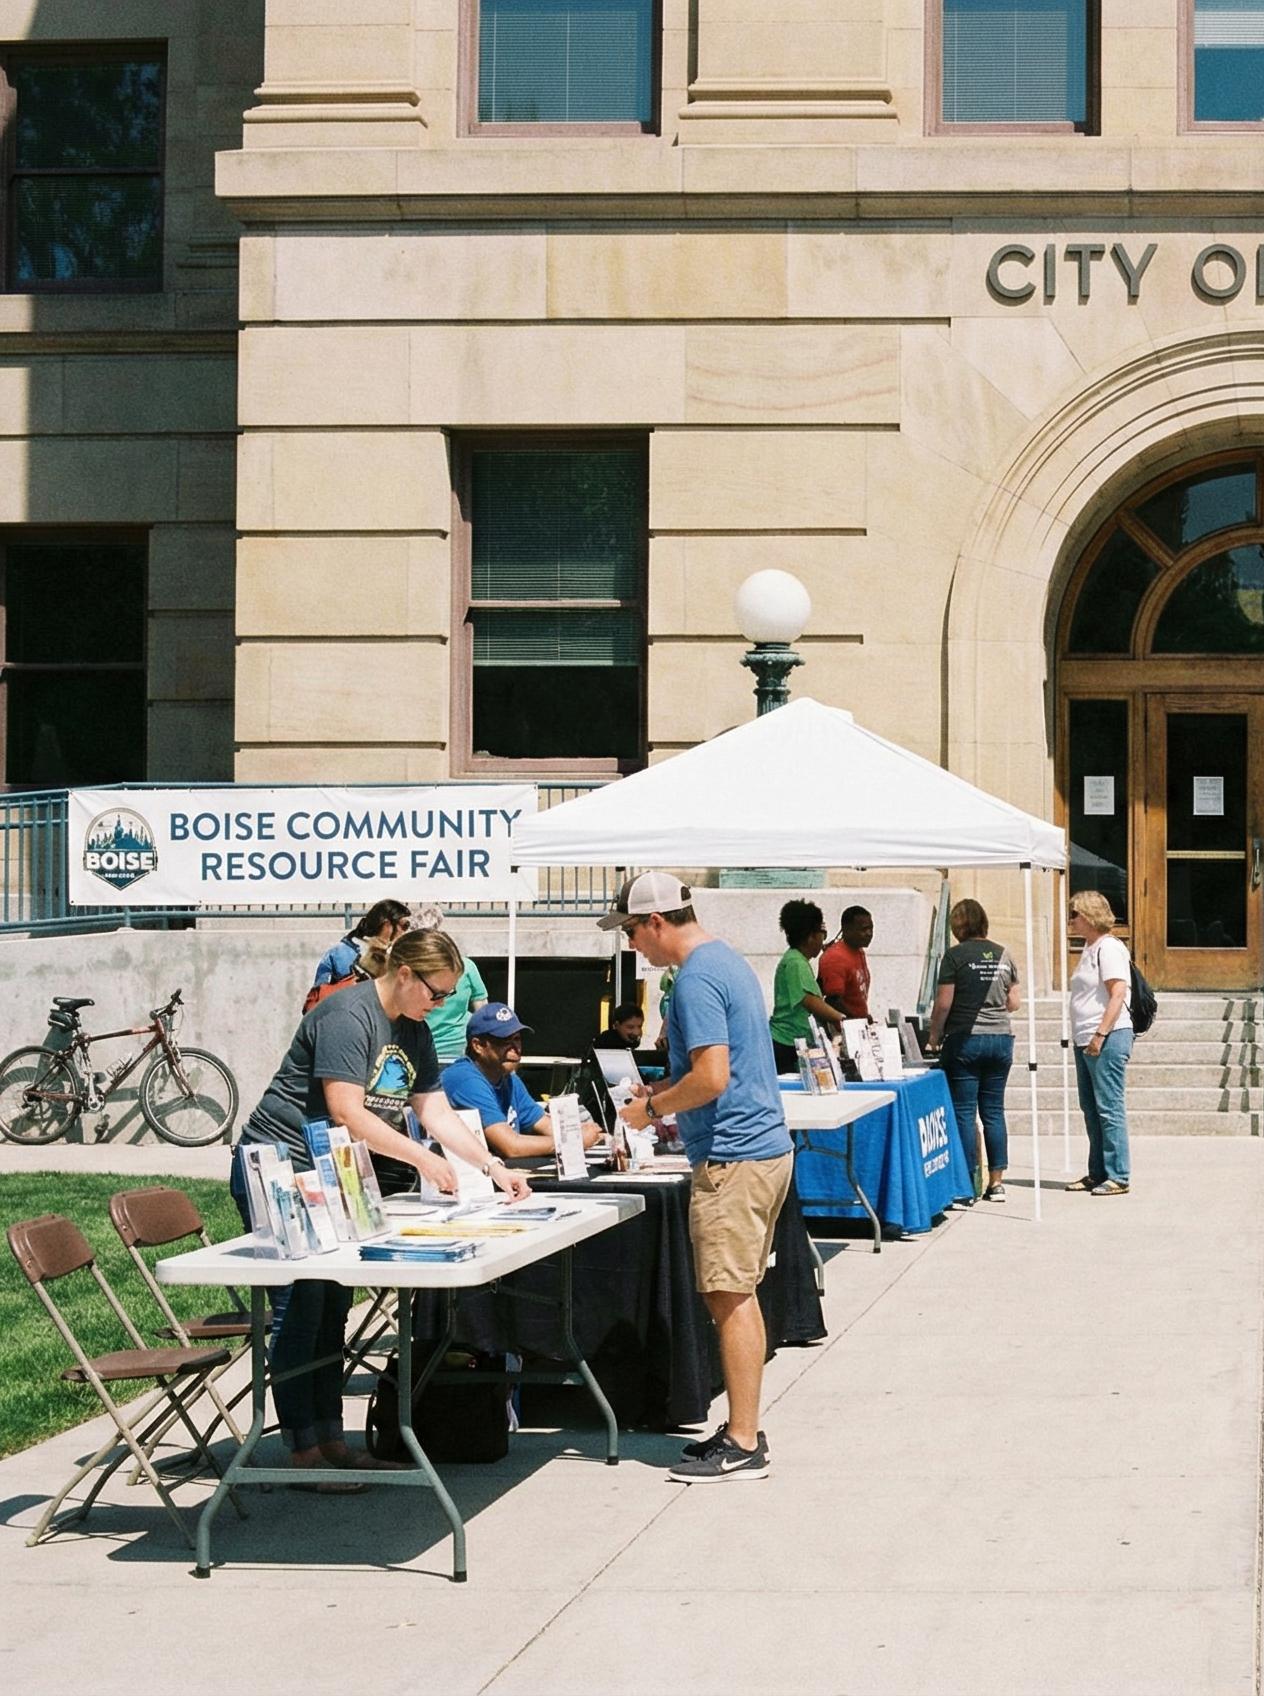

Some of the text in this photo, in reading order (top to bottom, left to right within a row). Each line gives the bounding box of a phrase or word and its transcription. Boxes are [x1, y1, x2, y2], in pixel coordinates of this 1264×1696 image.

[987, 243, 1158, 304] CITY
[170, 809, 523, 841] BOISE COMMUNITY
[86, 852, 155, 871] BOISE
[201, 849, 490, 881] RESOURCE FAIR
